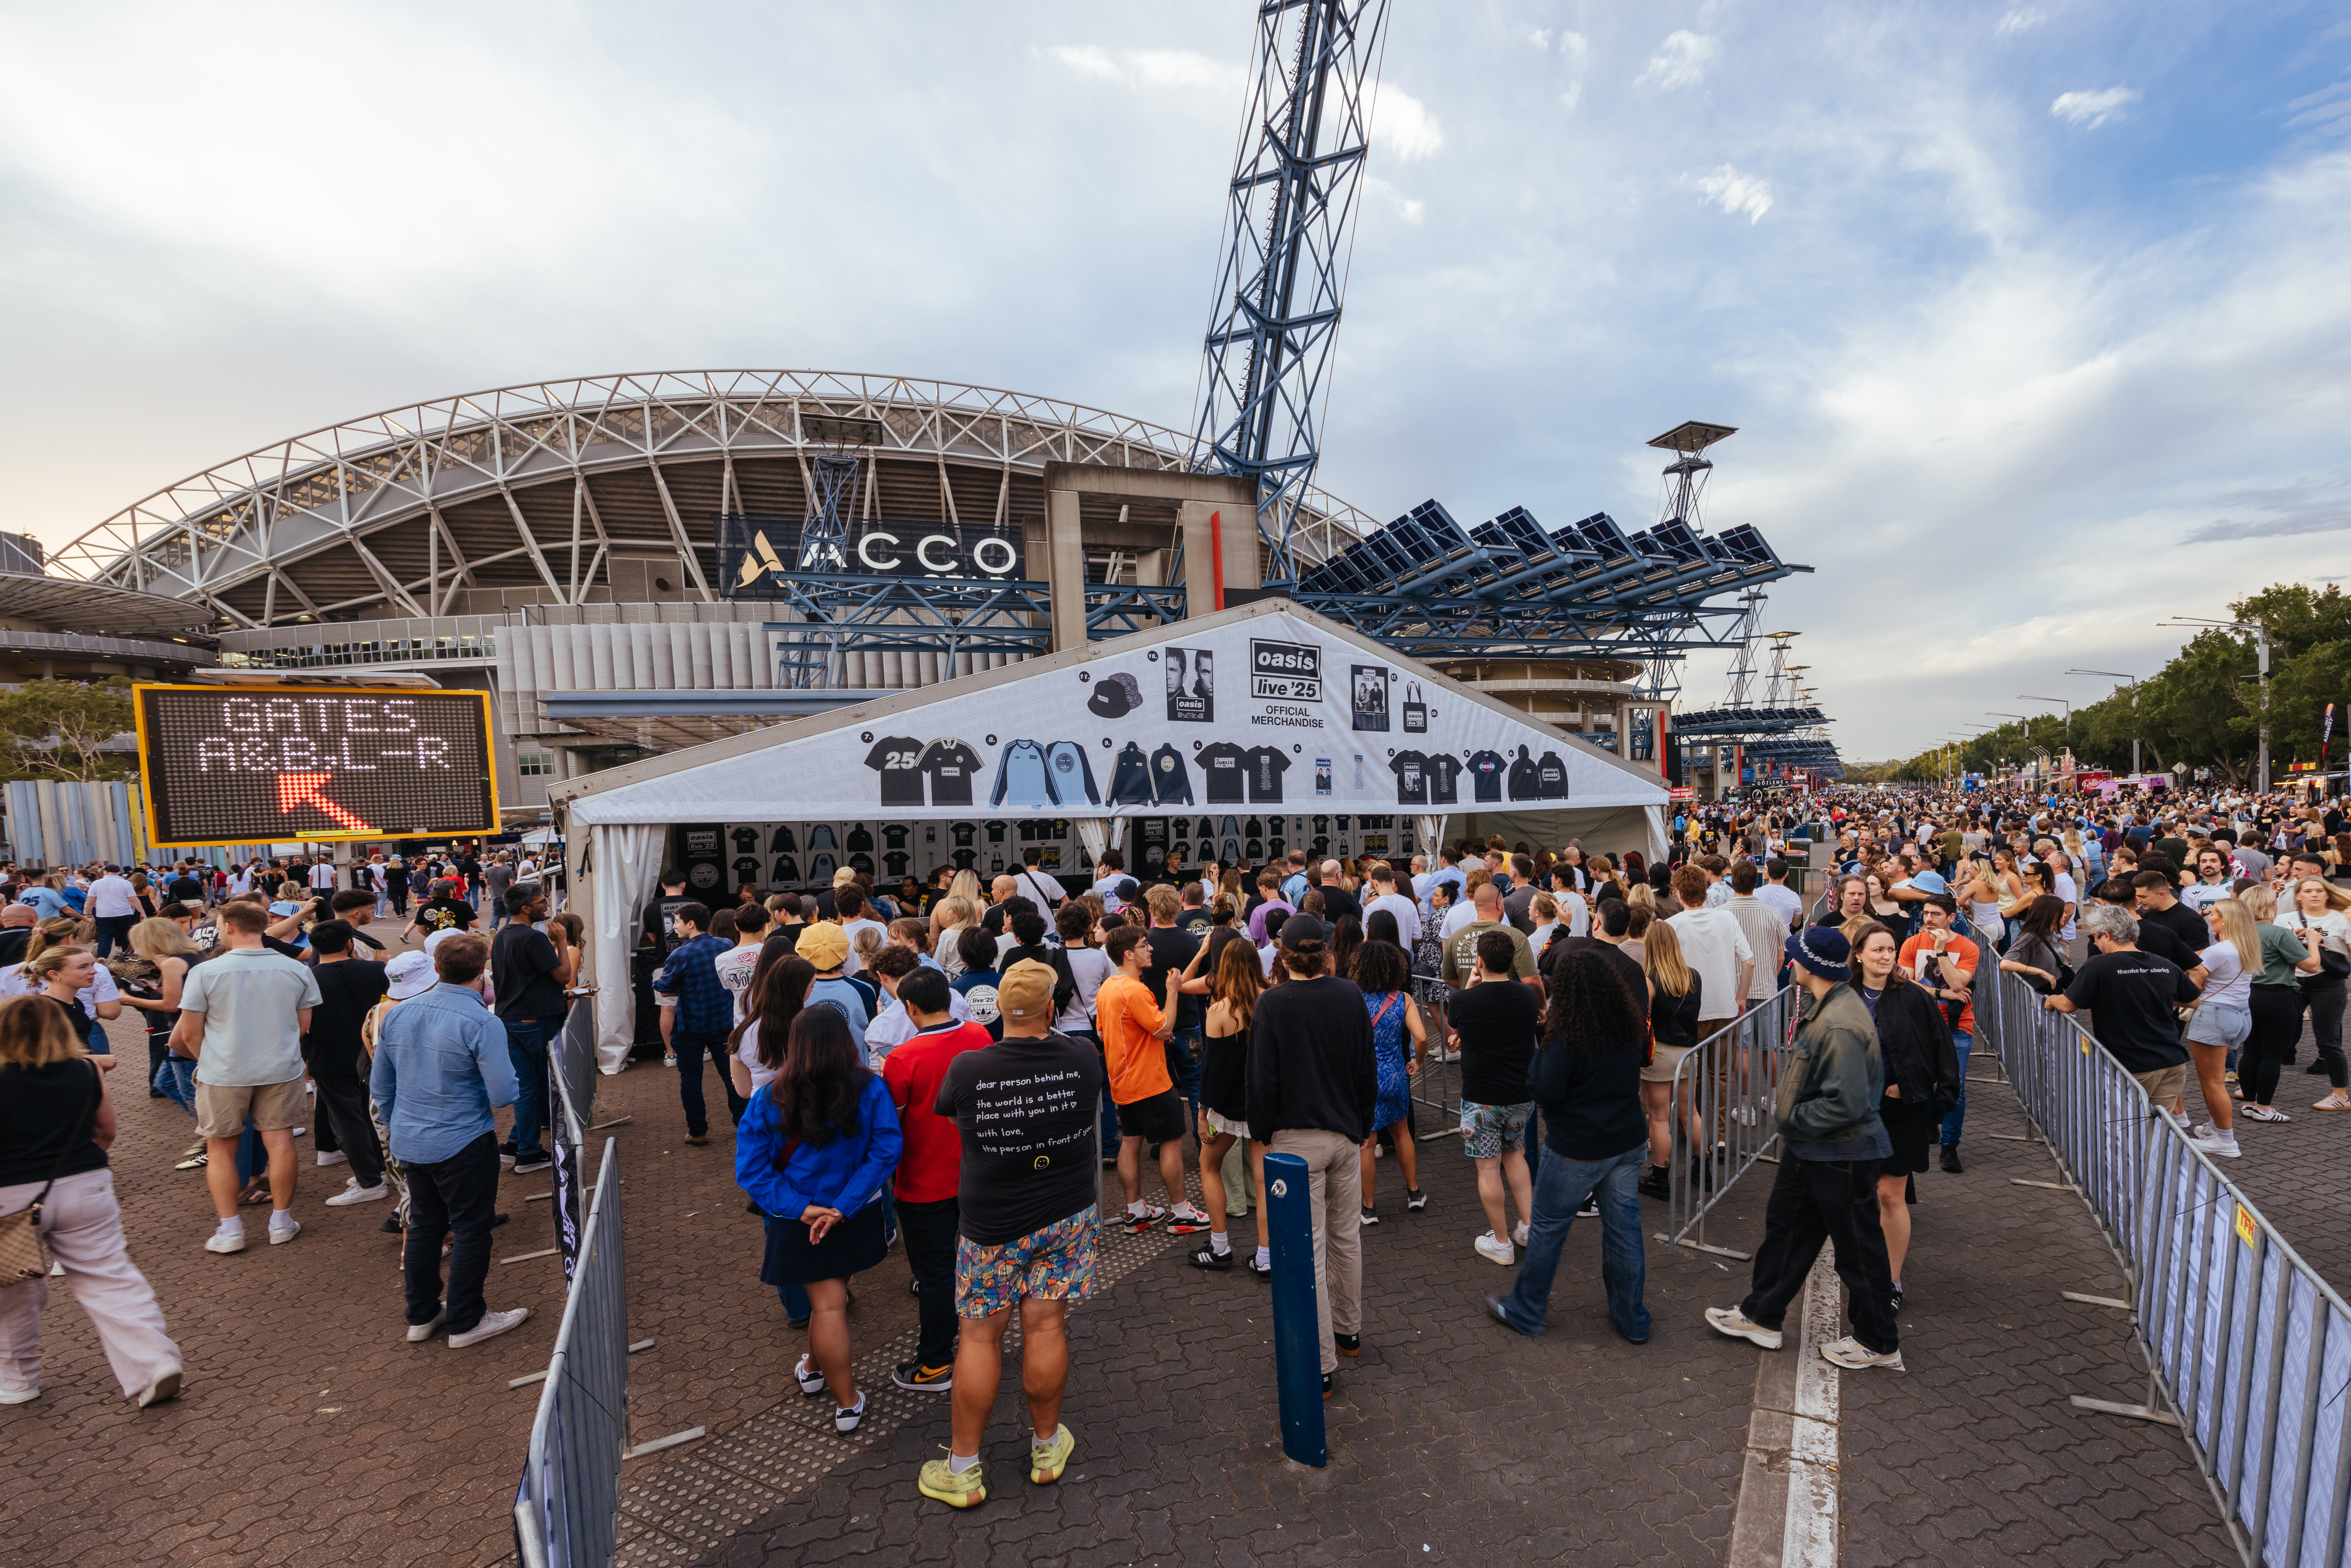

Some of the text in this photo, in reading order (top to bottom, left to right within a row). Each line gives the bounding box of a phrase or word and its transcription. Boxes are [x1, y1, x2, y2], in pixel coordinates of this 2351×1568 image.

[1257, 651, 1315, 671] oasis
[1257, 678, 1317, 698] live '25
[1178, 700, 1203, 708] oasis
[1265, 705, 1311, 717] OFFICIAL
[223, 698, 416, 732] GATES
[1251, 715, 1324, 728] MERCHANDISE
[1675, 735, 1679, 745] 5
[885, 752, 916, 770] 25
[21, 896, 40, 907] 25
[838, 1005, 848, 1018] STRIPES
[976, 1071, 1080, 1090] dear person behind me,
[976, 1100, 992, 1109] the
[995, 1096, 1022, 1107] world
[1047, 1090, 1075, 1101] better
[976, 1111, 999, 1123] place
[1003, 1108, 1024, 1118] with
[1029, 1107, 1045, 1118] you
[1061, 1101, 1069, 1111] it
[977, 1128, 1024, 1137] with love,
[1000, 1144, 1032, 1155] person
[1047, 1134, 1071, 1147] front
[1073, 1128, 1082, 1139] of
[1083, 1124, 1093, 1137] you
[2240, 1209, 2255, 1239] TFH
